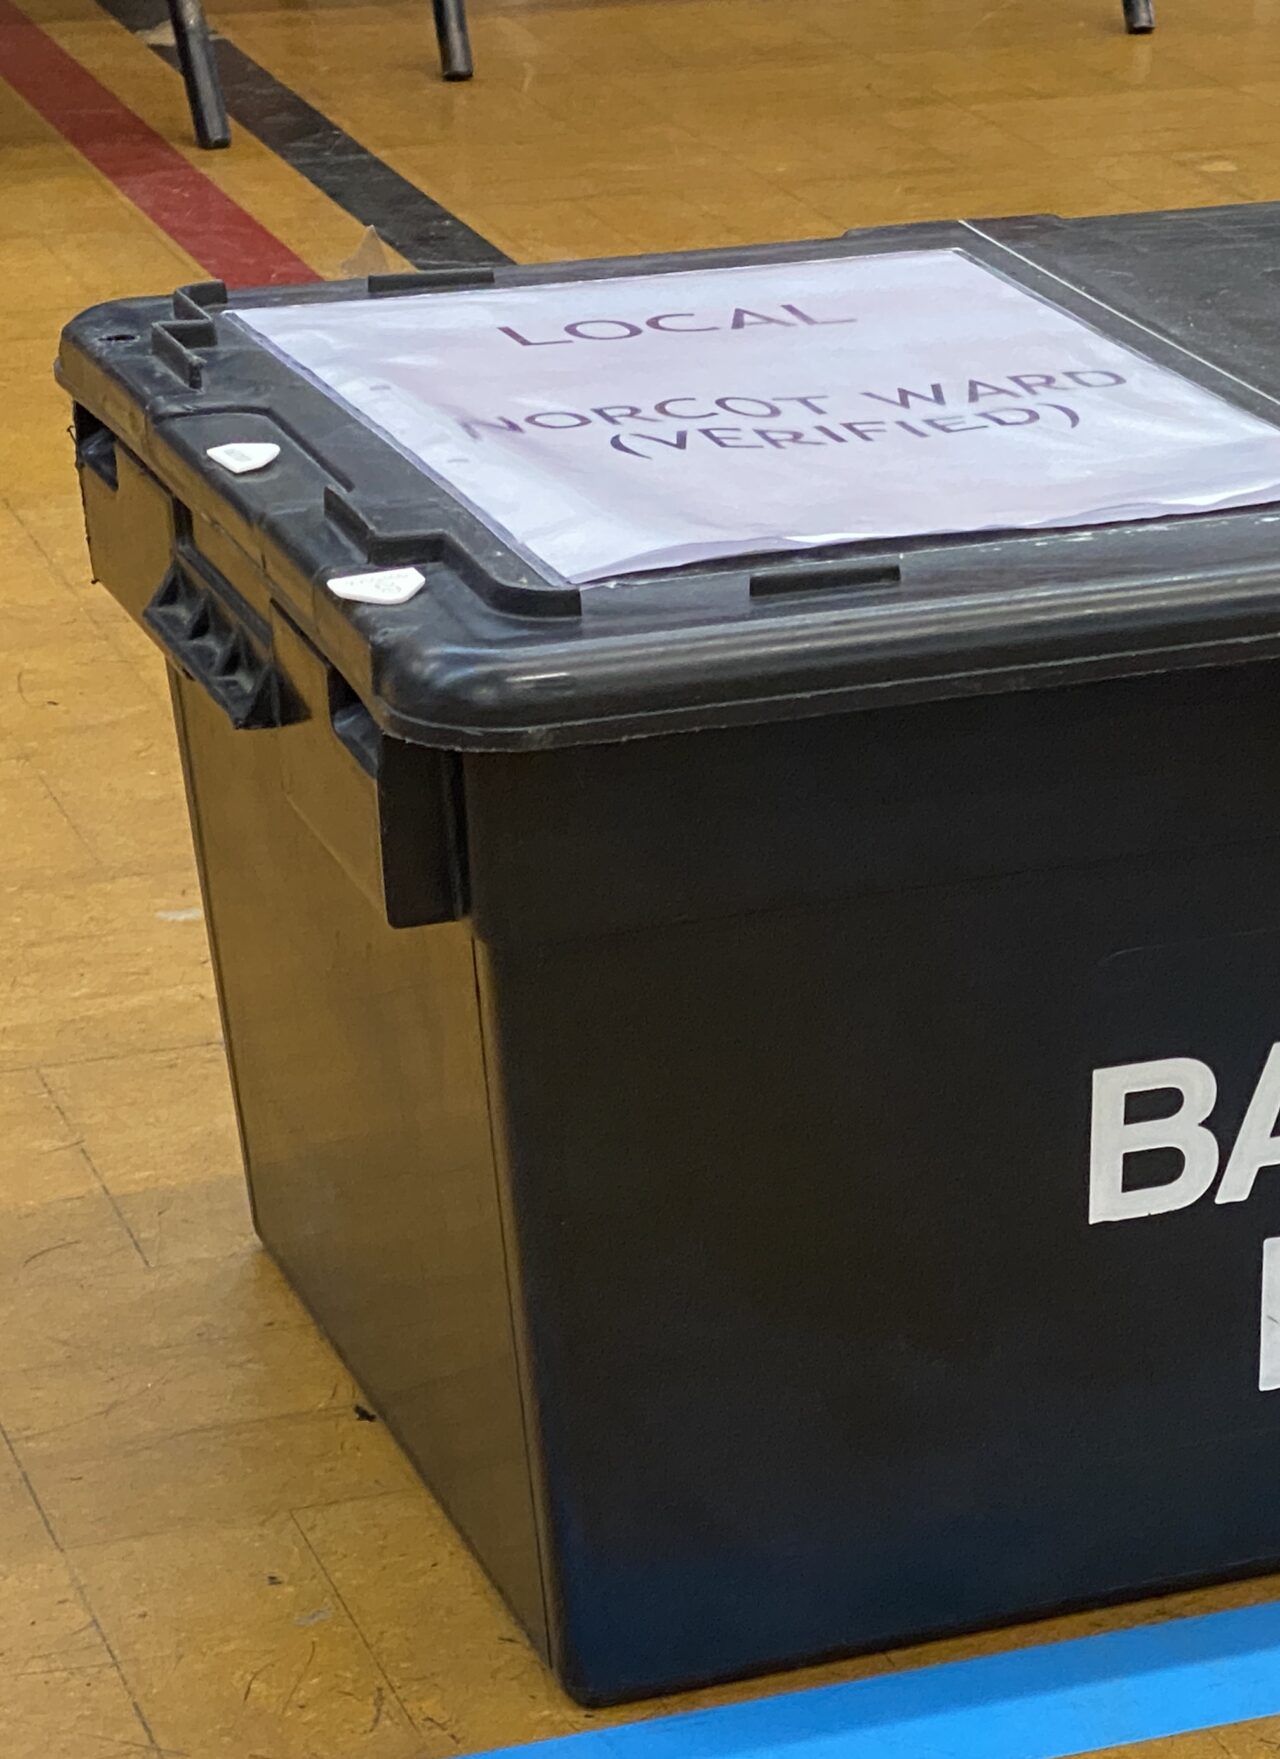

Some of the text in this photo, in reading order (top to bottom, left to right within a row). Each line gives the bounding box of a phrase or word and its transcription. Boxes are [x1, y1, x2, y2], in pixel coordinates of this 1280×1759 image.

[498, 304, 856, 346] LOCAL
[459, 370, 1127, 438] NORCOT WARD
[609, 403, 1080, 458] (VERIFIED)
